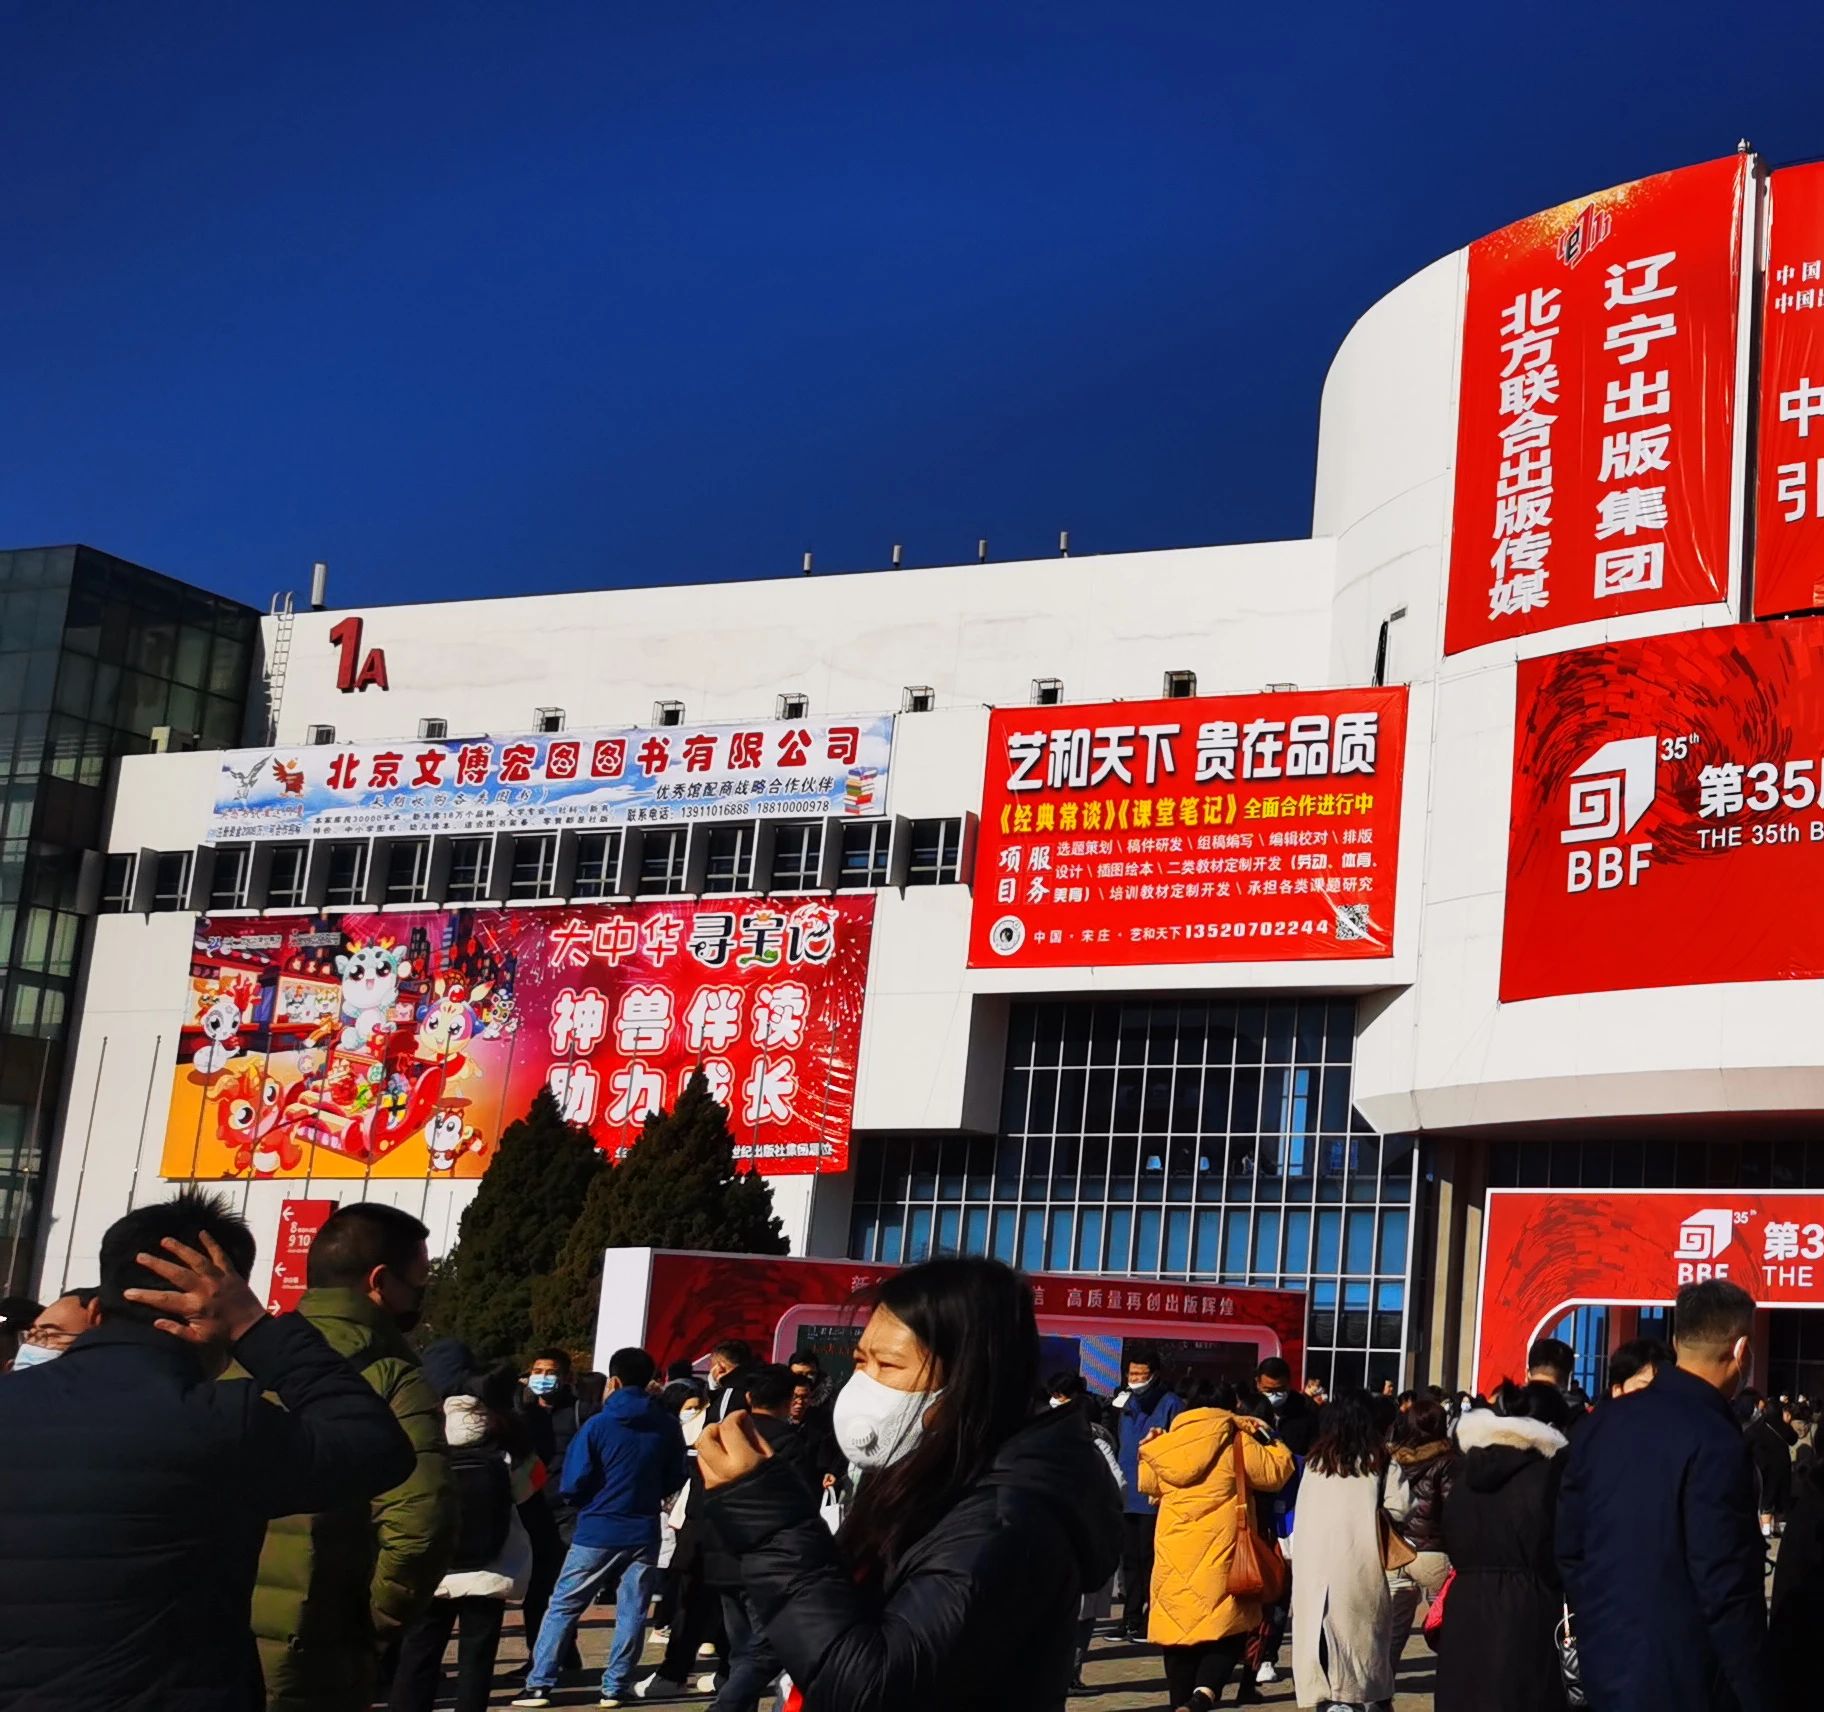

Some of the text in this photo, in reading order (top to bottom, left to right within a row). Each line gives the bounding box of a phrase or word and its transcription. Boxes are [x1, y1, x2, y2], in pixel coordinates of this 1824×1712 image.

[1594, 250, 1677, 599] 辽宁出版集团
[1487, 287, 1561, 621] 北方联合出版传媒
[330, 616, 389, 693] 1A
[1006, 711, 1378, 791] 艺和天下 贵在品质
[656, 777, 835, 801] 优秀馆配商战略合作伙伴
[1697, 826, 1743, 850] THE
[1751, 821, 1800, 846] 35th
[1566, 843, 1653, 893] BBF
[1185, 919, 1328, 940] 13520702244
[550, 982, 810, 1055] 神兽伴读
[290, 1221, 298, 1233] 8
[1762, 1266, 1813, 1287] THE
[1067, 1287, 1234, 1316] 高质量再创出版辉煌
